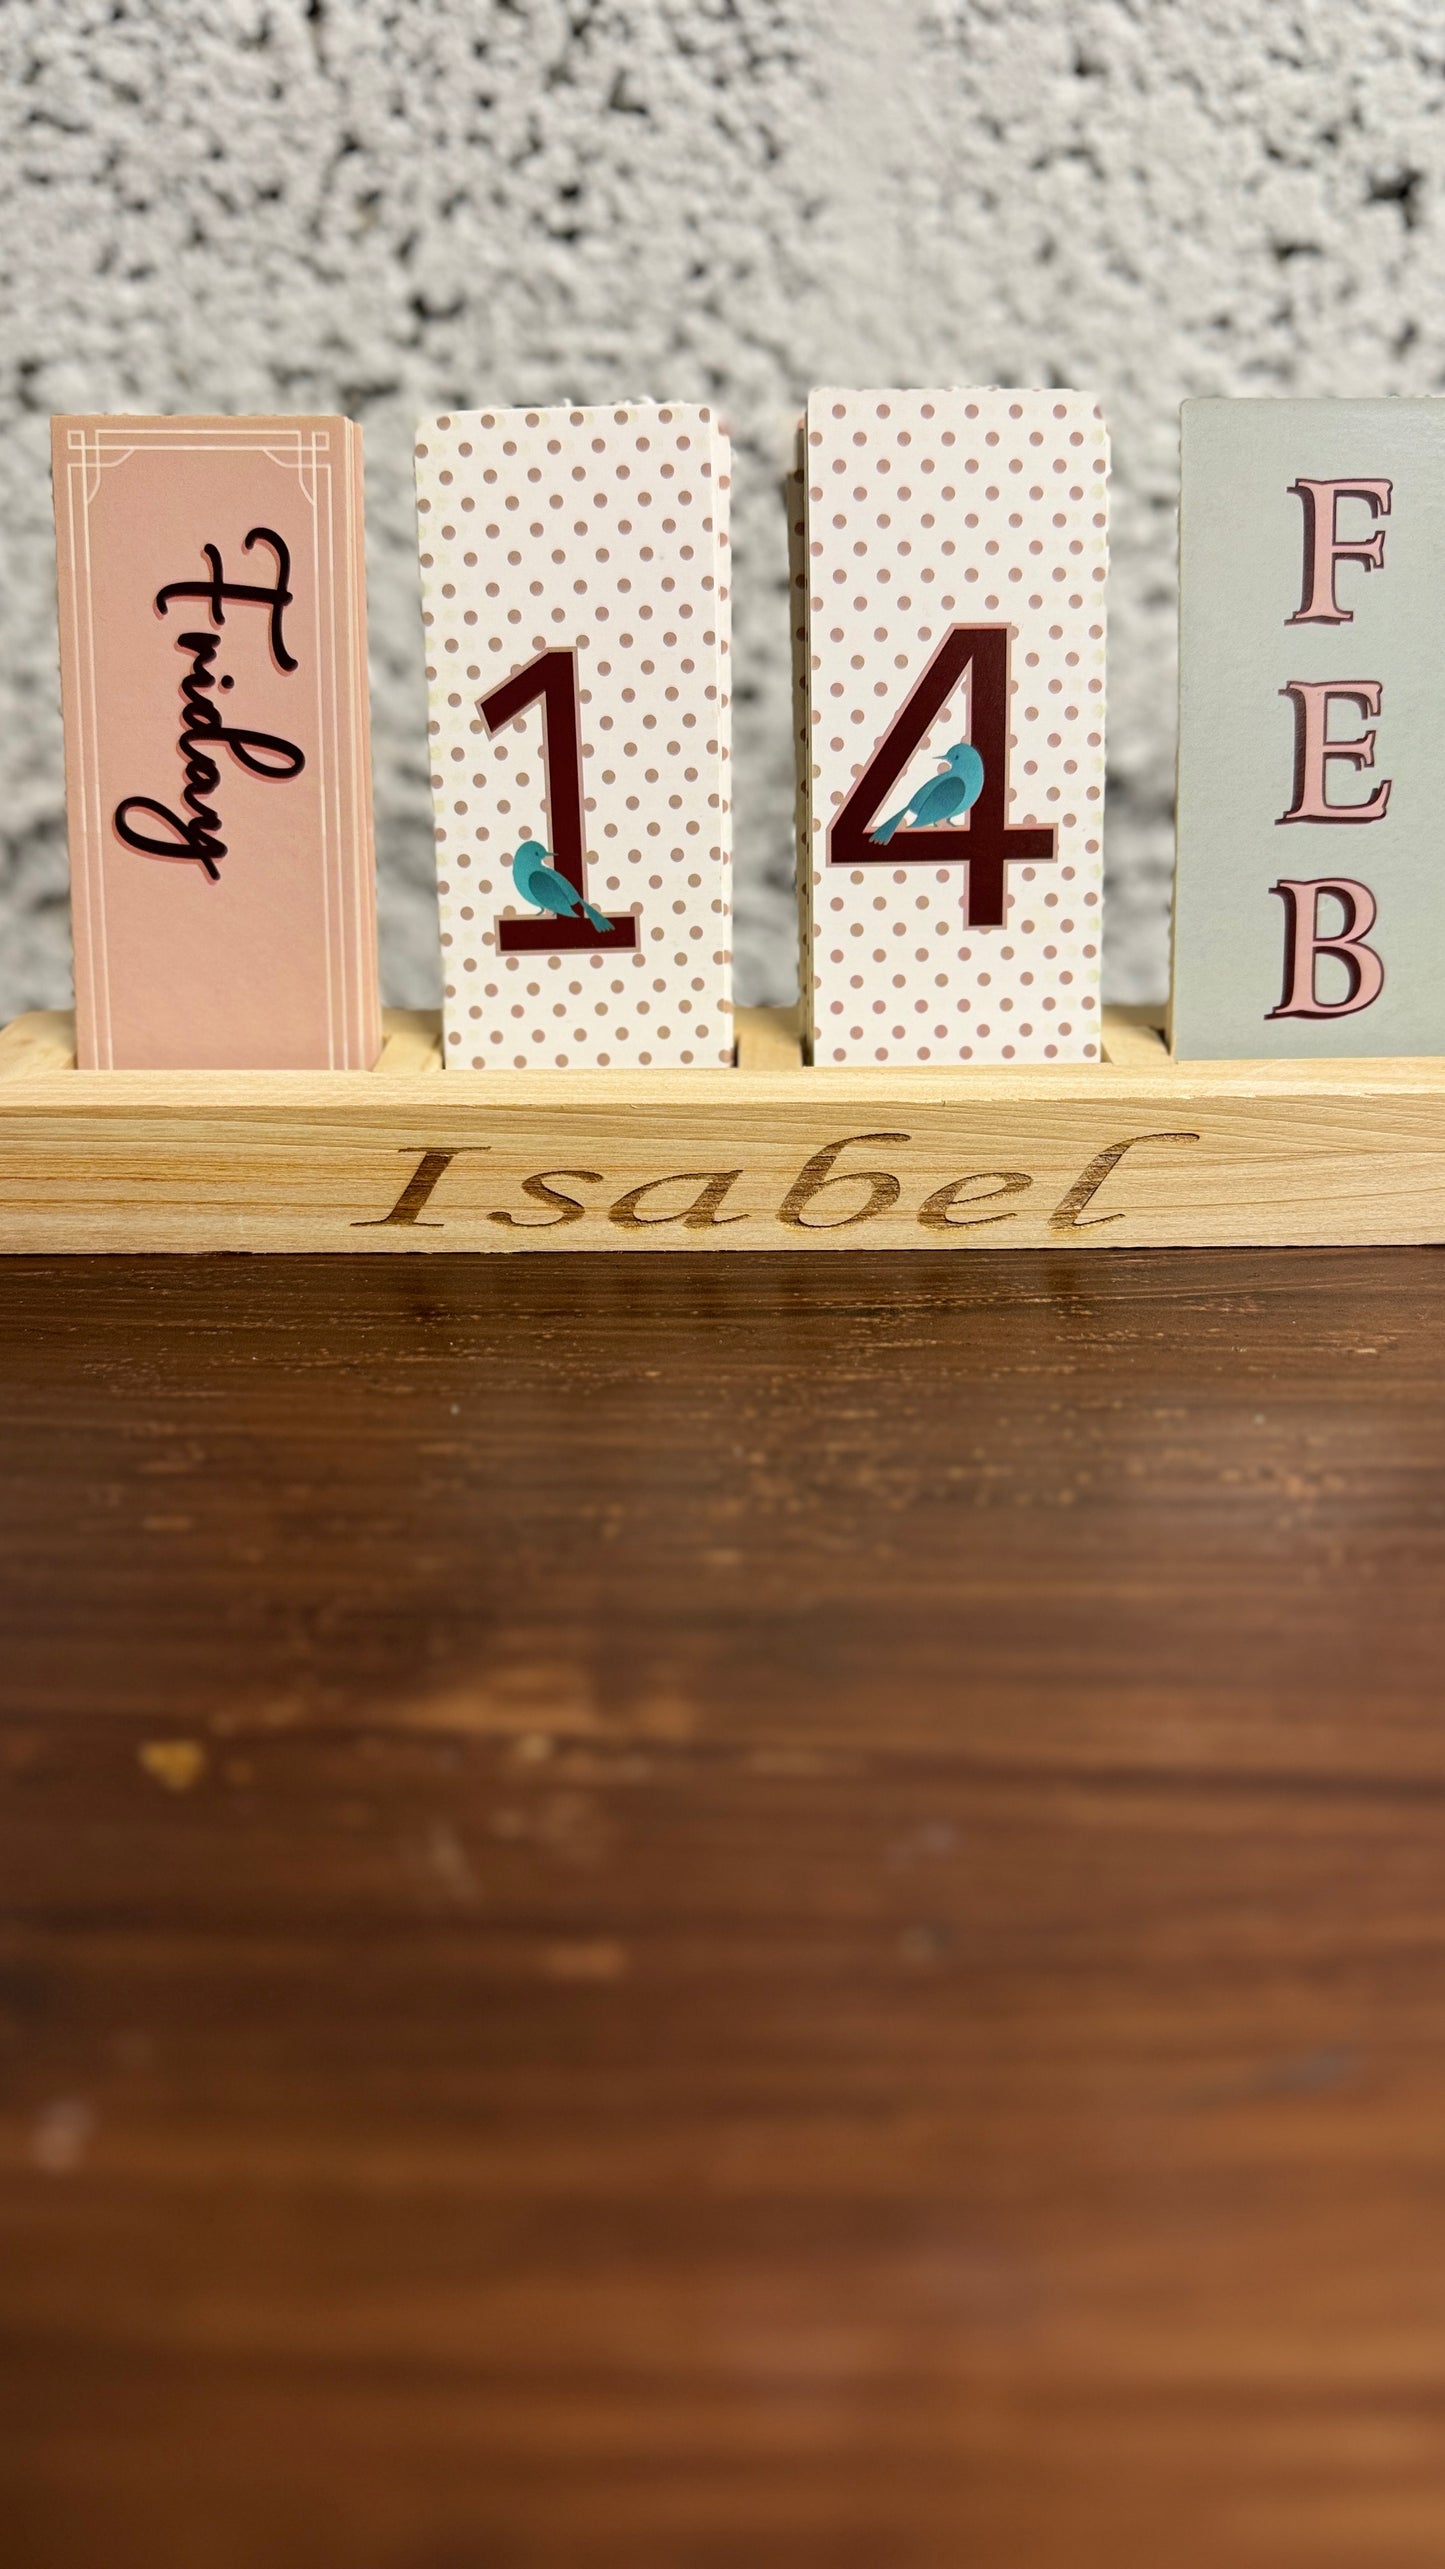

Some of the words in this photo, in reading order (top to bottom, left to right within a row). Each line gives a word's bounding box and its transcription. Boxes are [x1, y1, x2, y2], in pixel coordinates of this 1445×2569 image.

[112, 527, 305, 883] Friday
[476, 646, 641, 955] 1
[826, 622, 1058, 930] 4
[1264, 477, 1393, 1021] FEB
[350, 1131, 1201, 1231] Isabel
